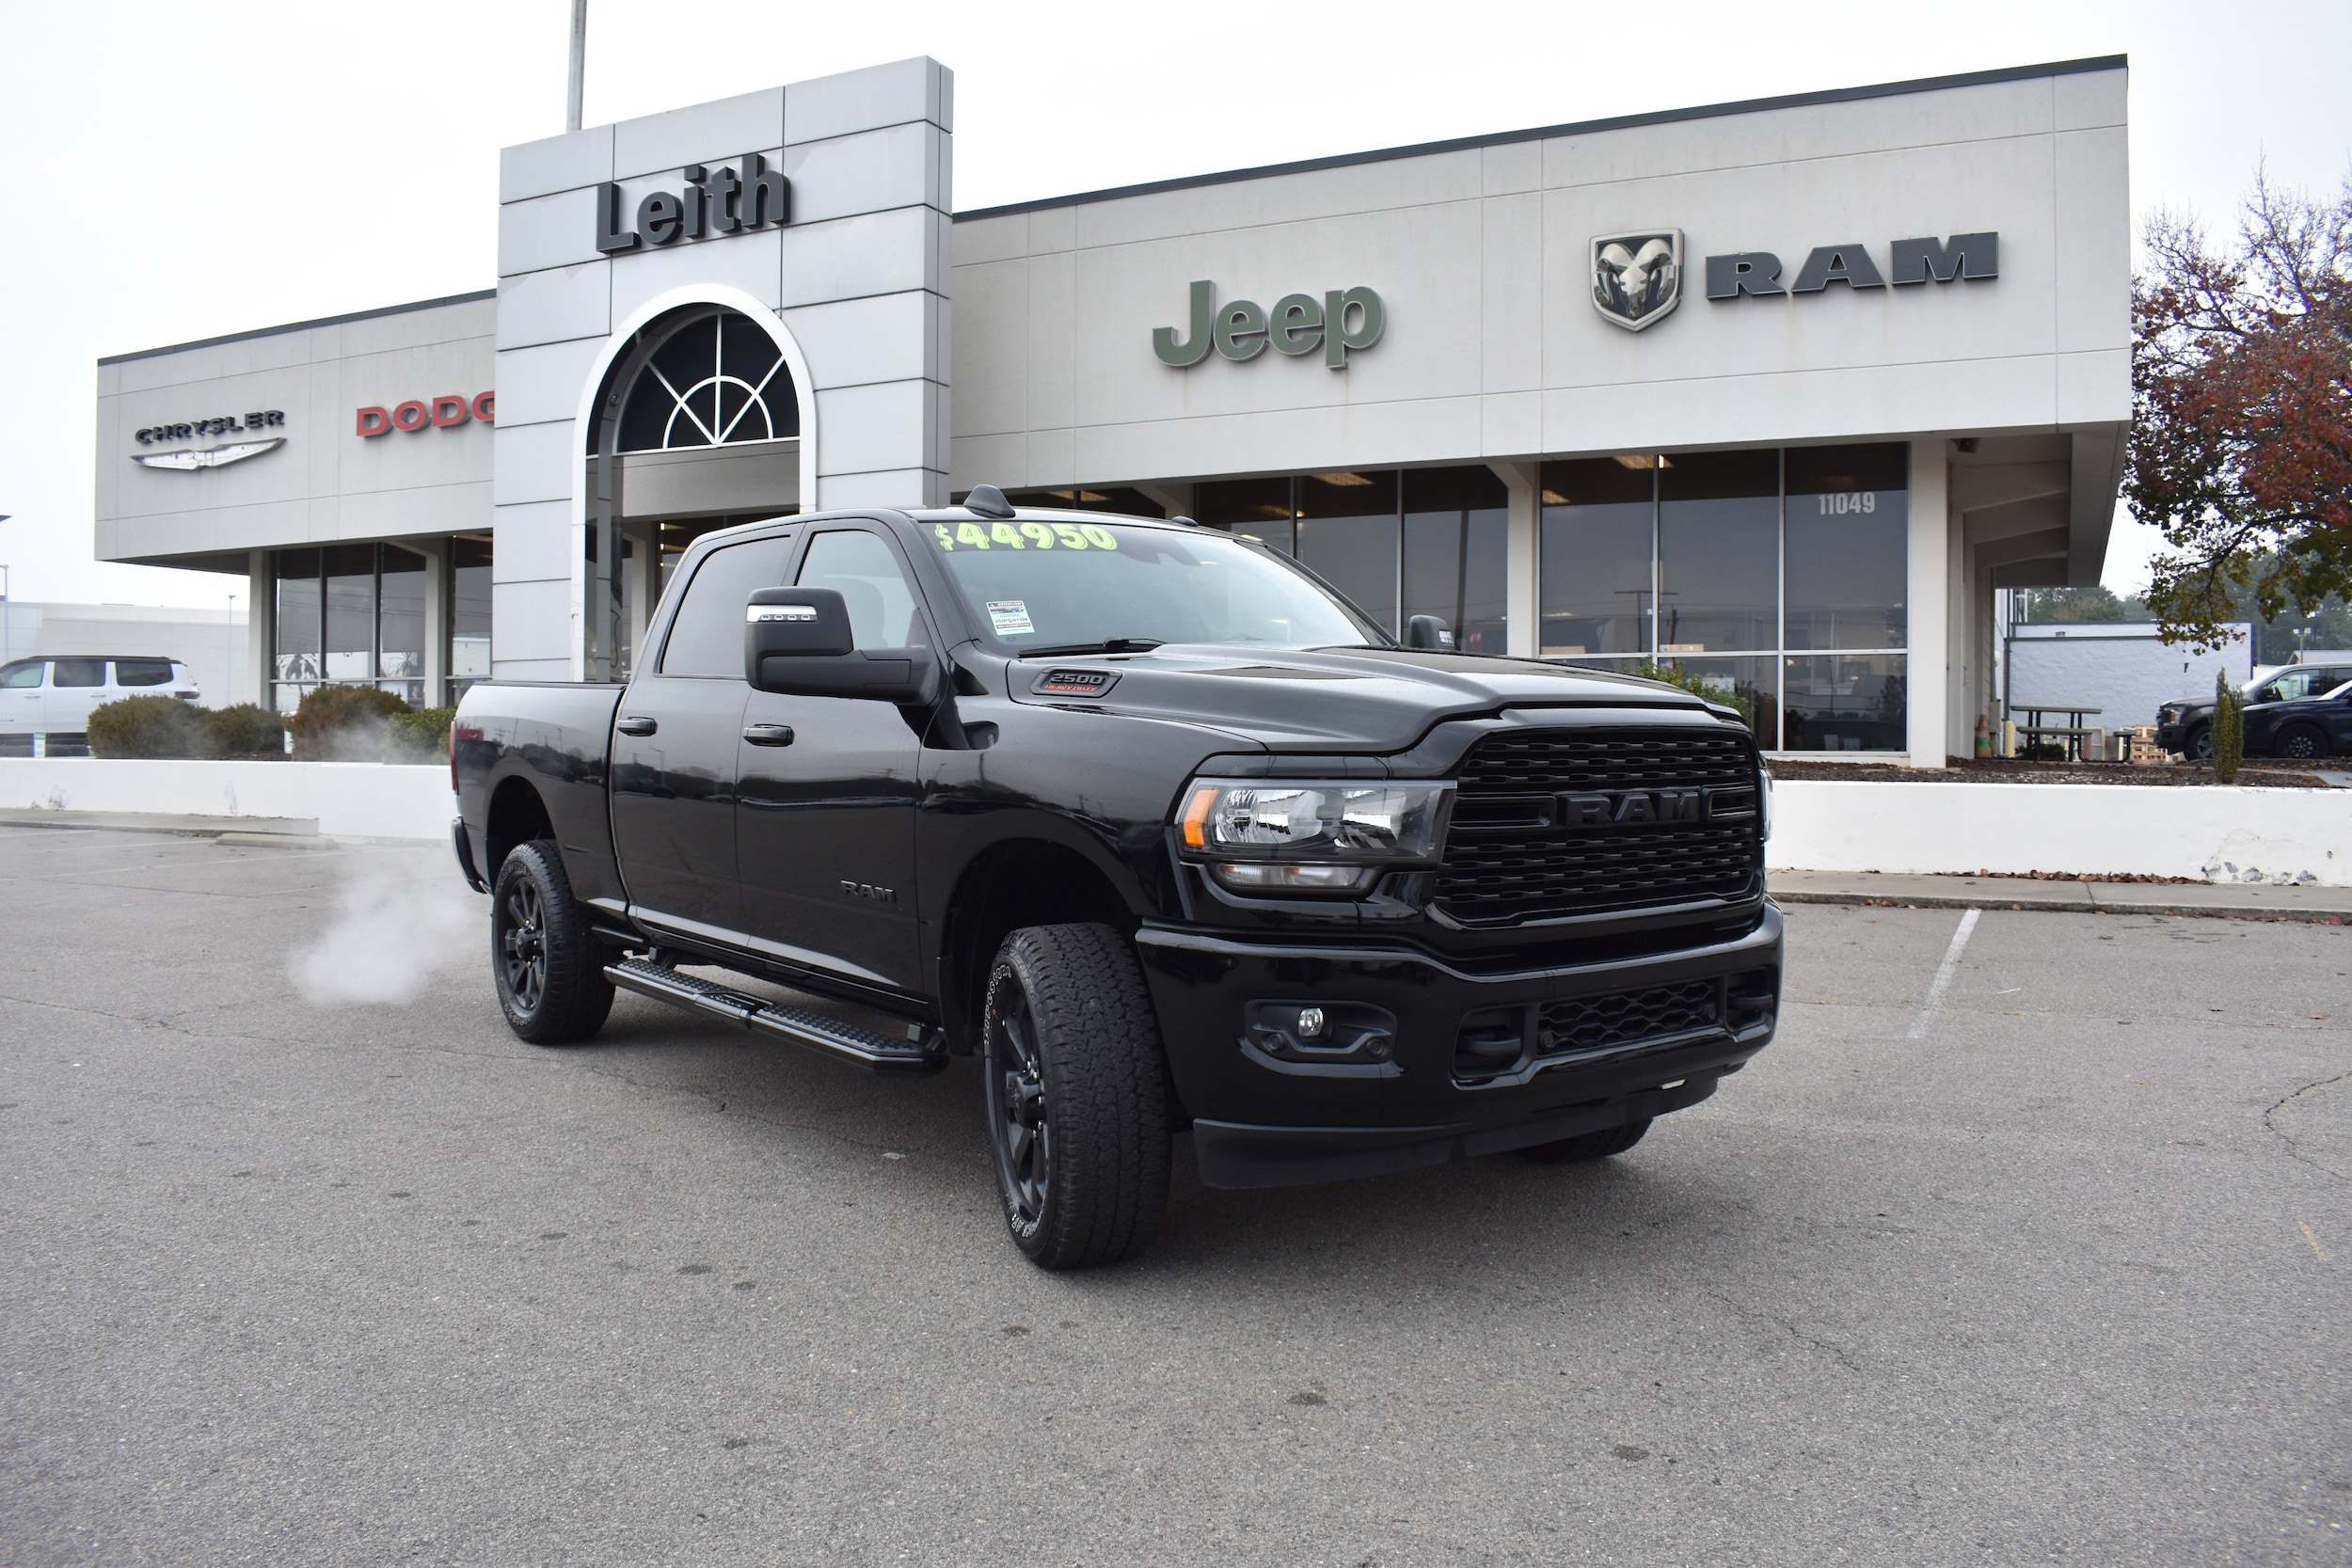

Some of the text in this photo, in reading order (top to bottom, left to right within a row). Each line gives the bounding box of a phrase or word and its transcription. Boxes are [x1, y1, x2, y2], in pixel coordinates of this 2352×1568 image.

[596, 152, 790, 255] Leith
[1705, 231, 1999, 301] RAM
[1152, 279, 1387, 371] Jeep
[135, 409, 285, 444] CHRYSLER
[1819, 491, 1875, 515] 11049
[934, 522, 1118, 551] $44950
[1044, 684, 1073, 692] HEAVY
[1050, 673, 1104, 685] 2500
[1565, 791, 1700, 827] RAM
[840, 879, 897, 903] RAM
